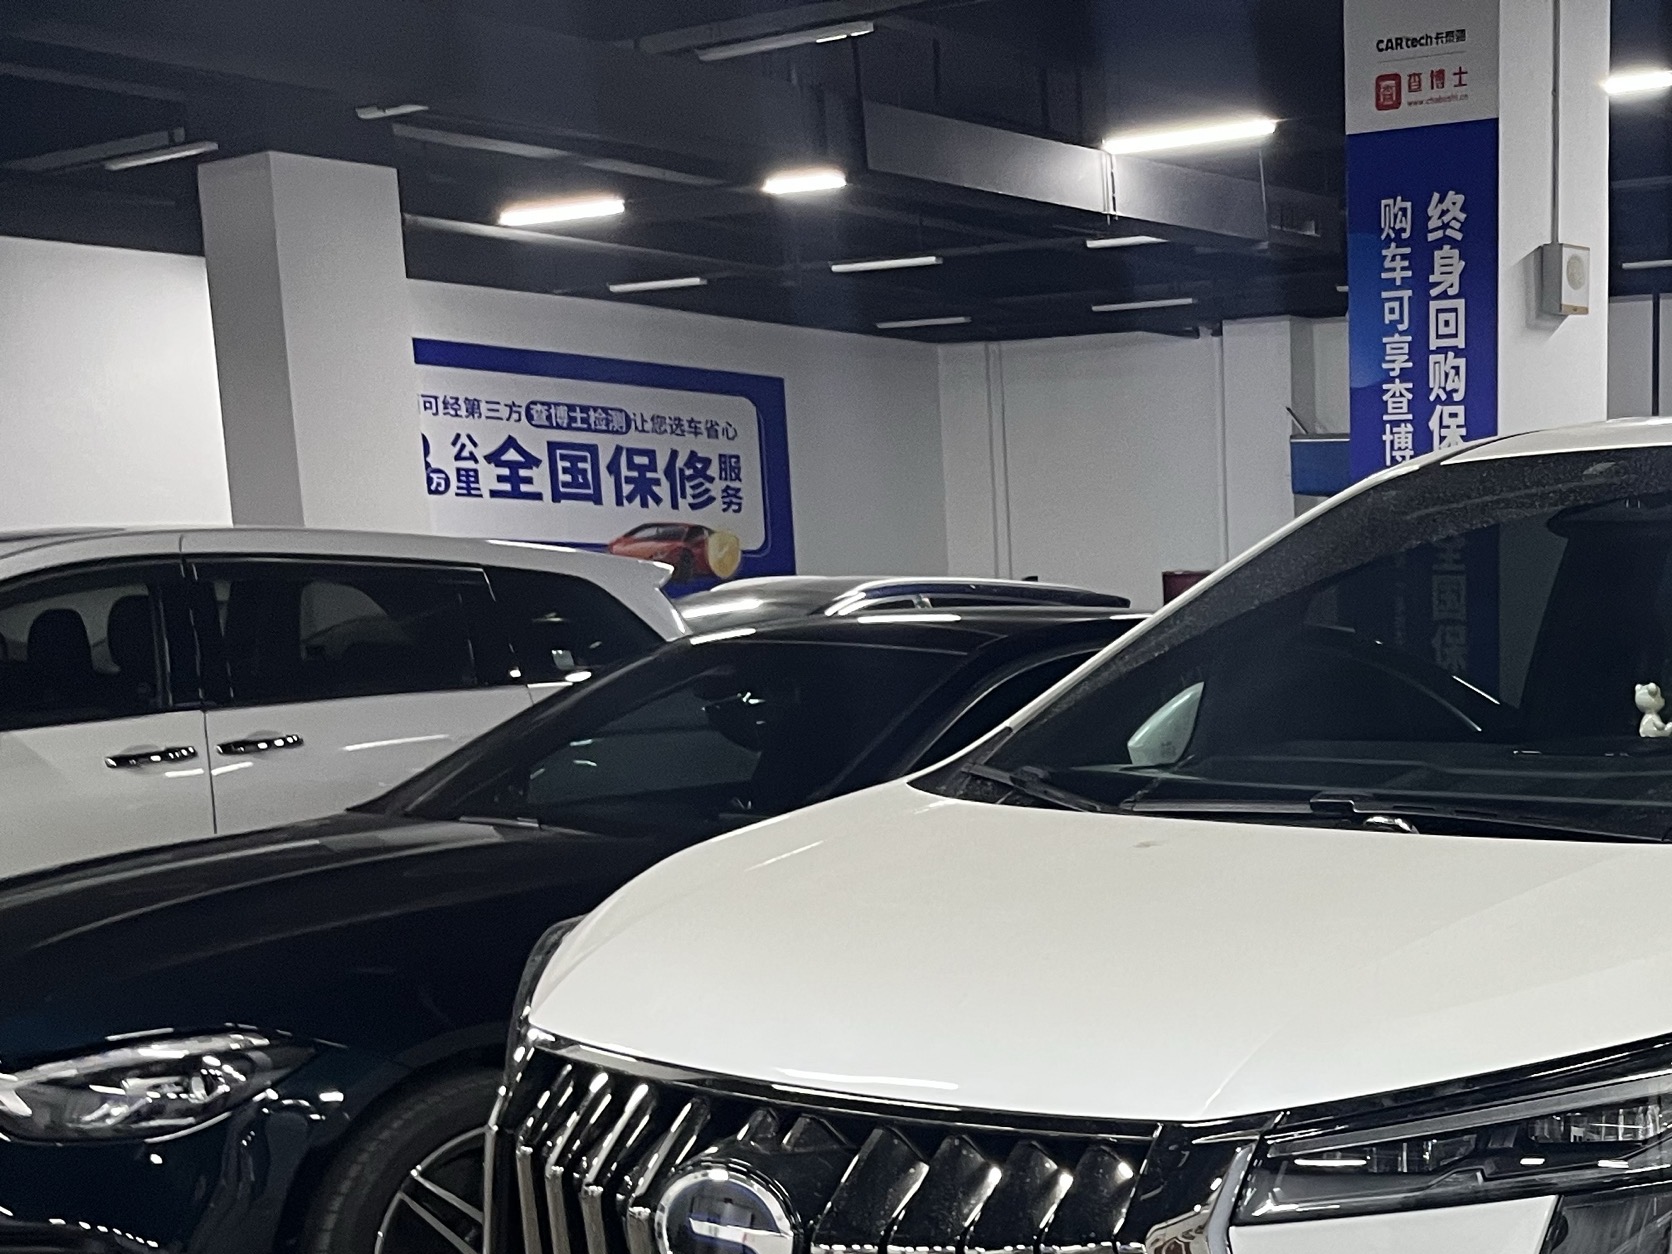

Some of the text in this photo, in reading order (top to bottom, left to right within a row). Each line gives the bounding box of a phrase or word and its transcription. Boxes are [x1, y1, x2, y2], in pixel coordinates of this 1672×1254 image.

[483, 434, 716, 511] 全国保修
[718, 453, 743, 513] 服务
